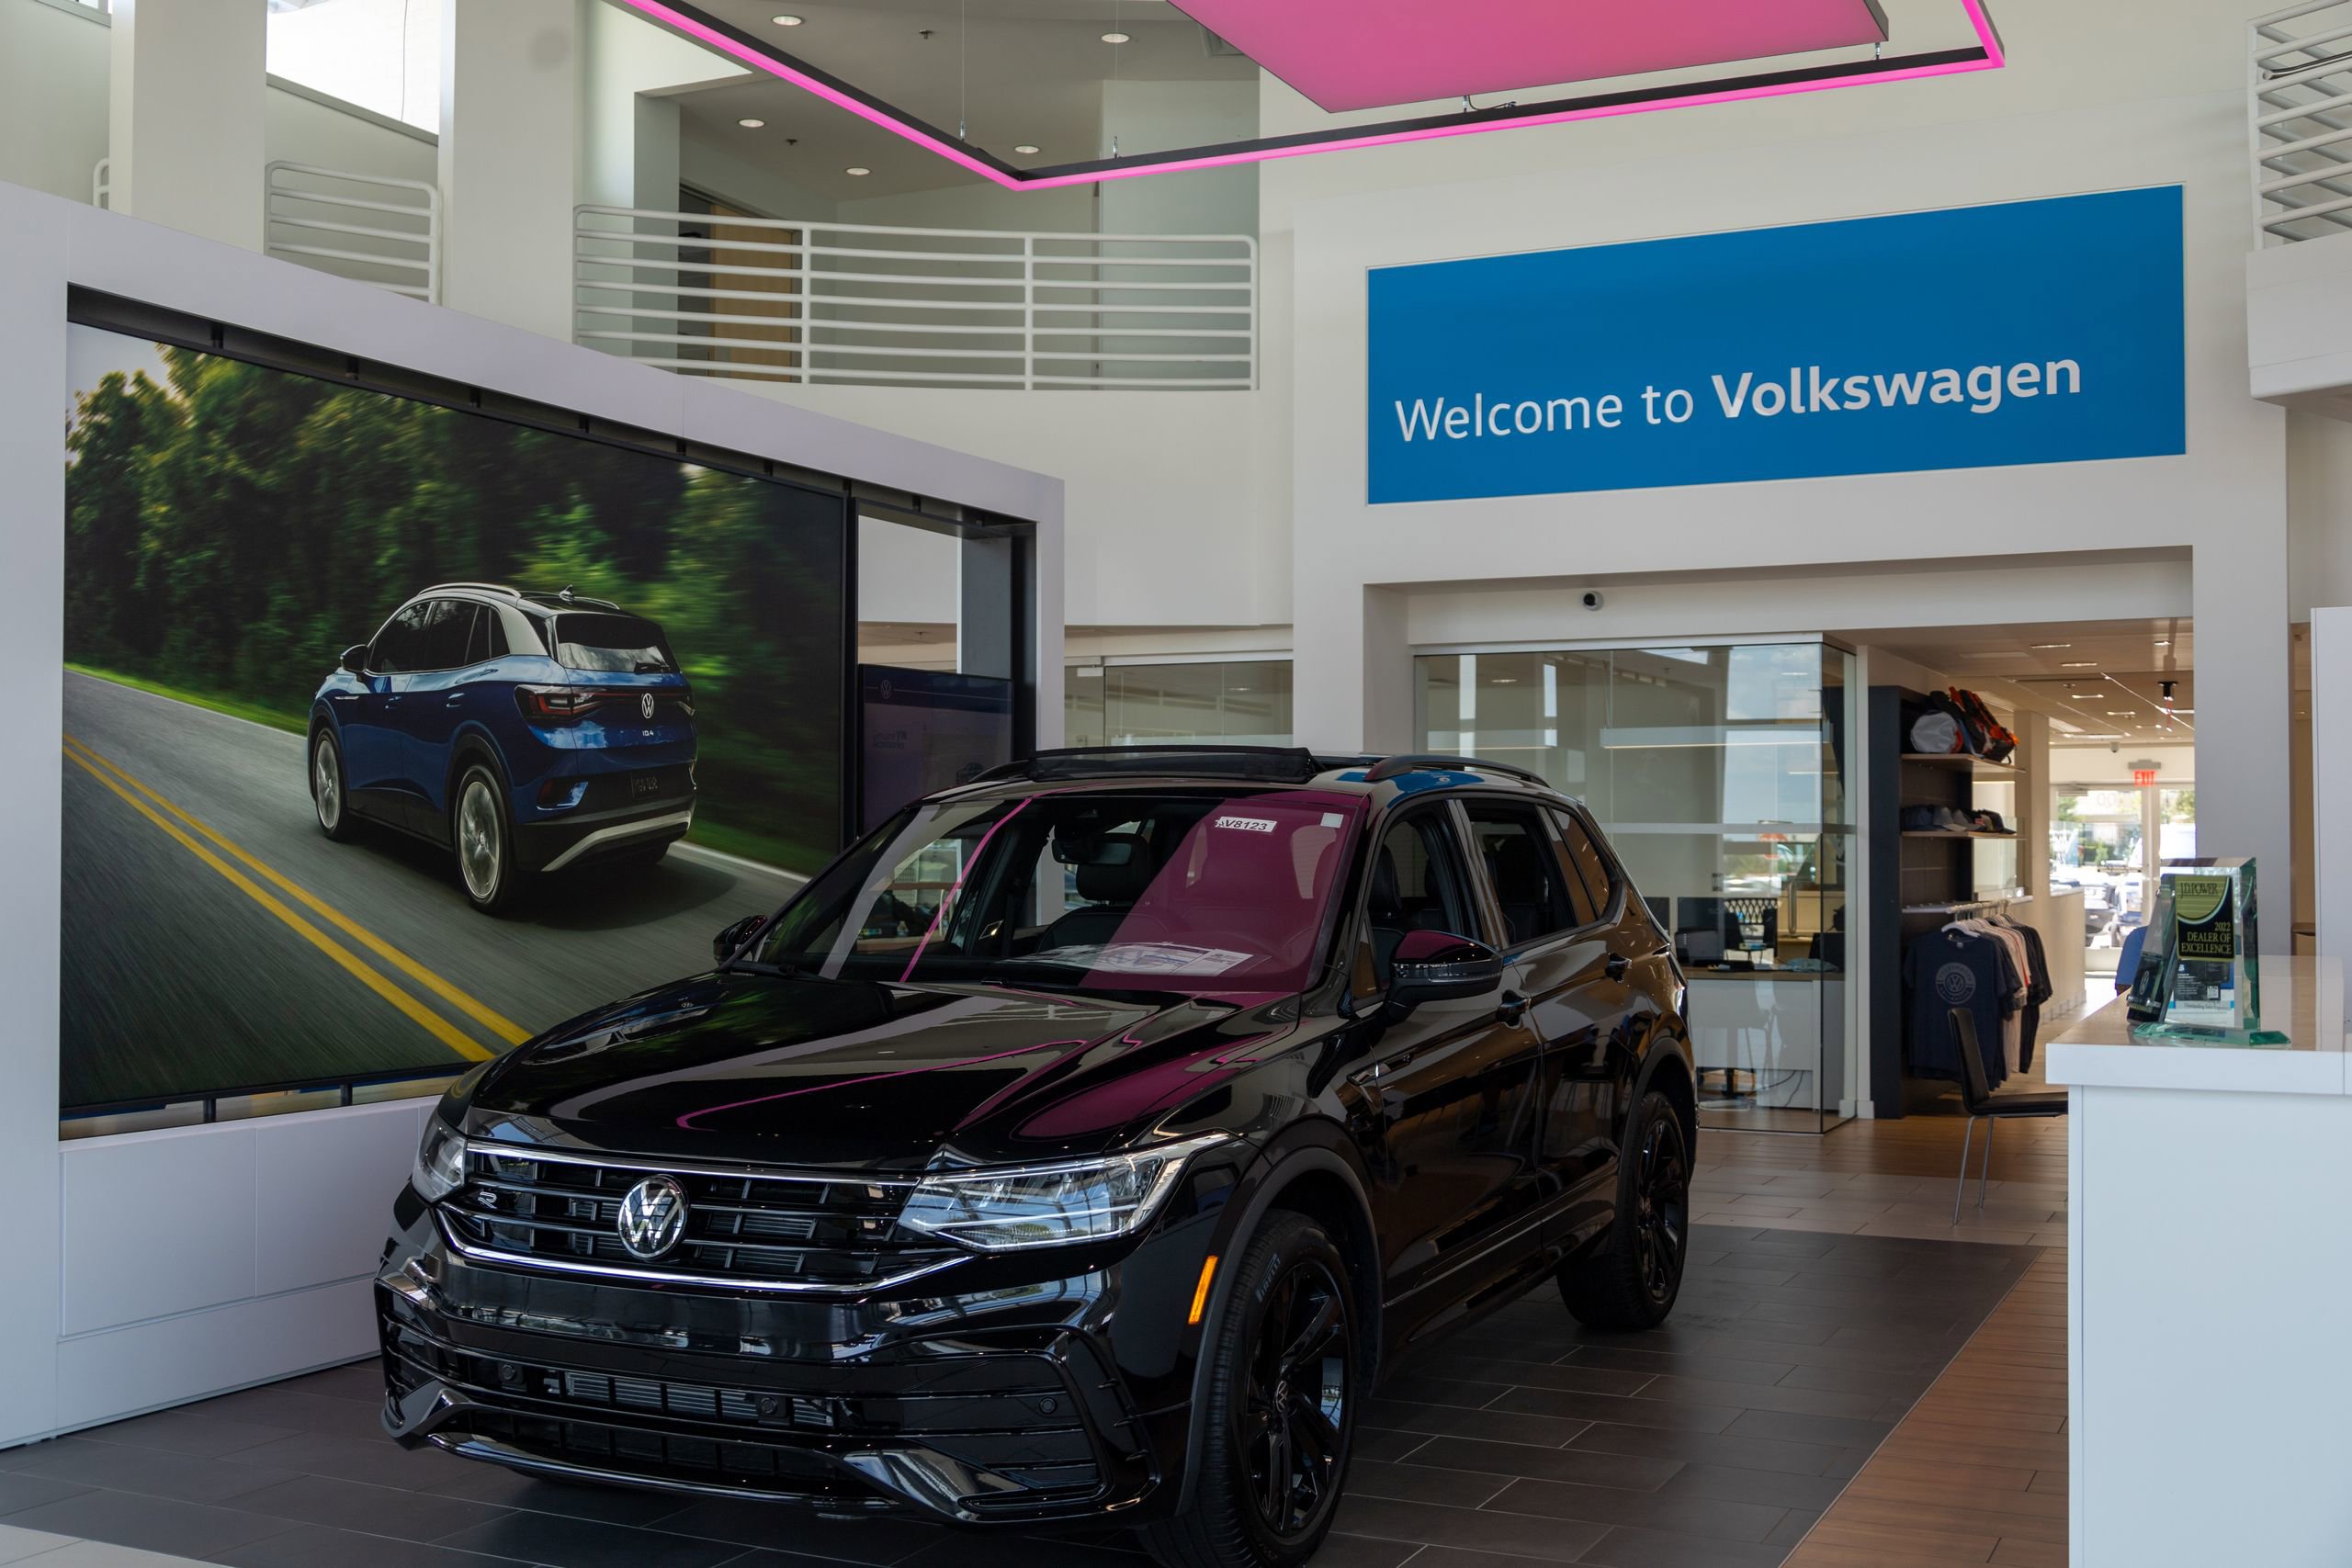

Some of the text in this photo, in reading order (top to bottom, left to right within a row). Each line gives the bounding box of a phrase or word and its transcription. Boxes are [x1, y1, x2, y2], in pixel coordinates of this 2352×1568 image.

[1395, 359, 2080, 442] Welcome to Volkswagen
[2134, 770, 2156, 787] EXIT
[2214, 921, 2232, 931] 2022
[2187, 931, 2232, 942] DEALER OF
[2180, 942, 2233, 954] EXCELLENCE
[619, 1176, 687, 1258] VW
